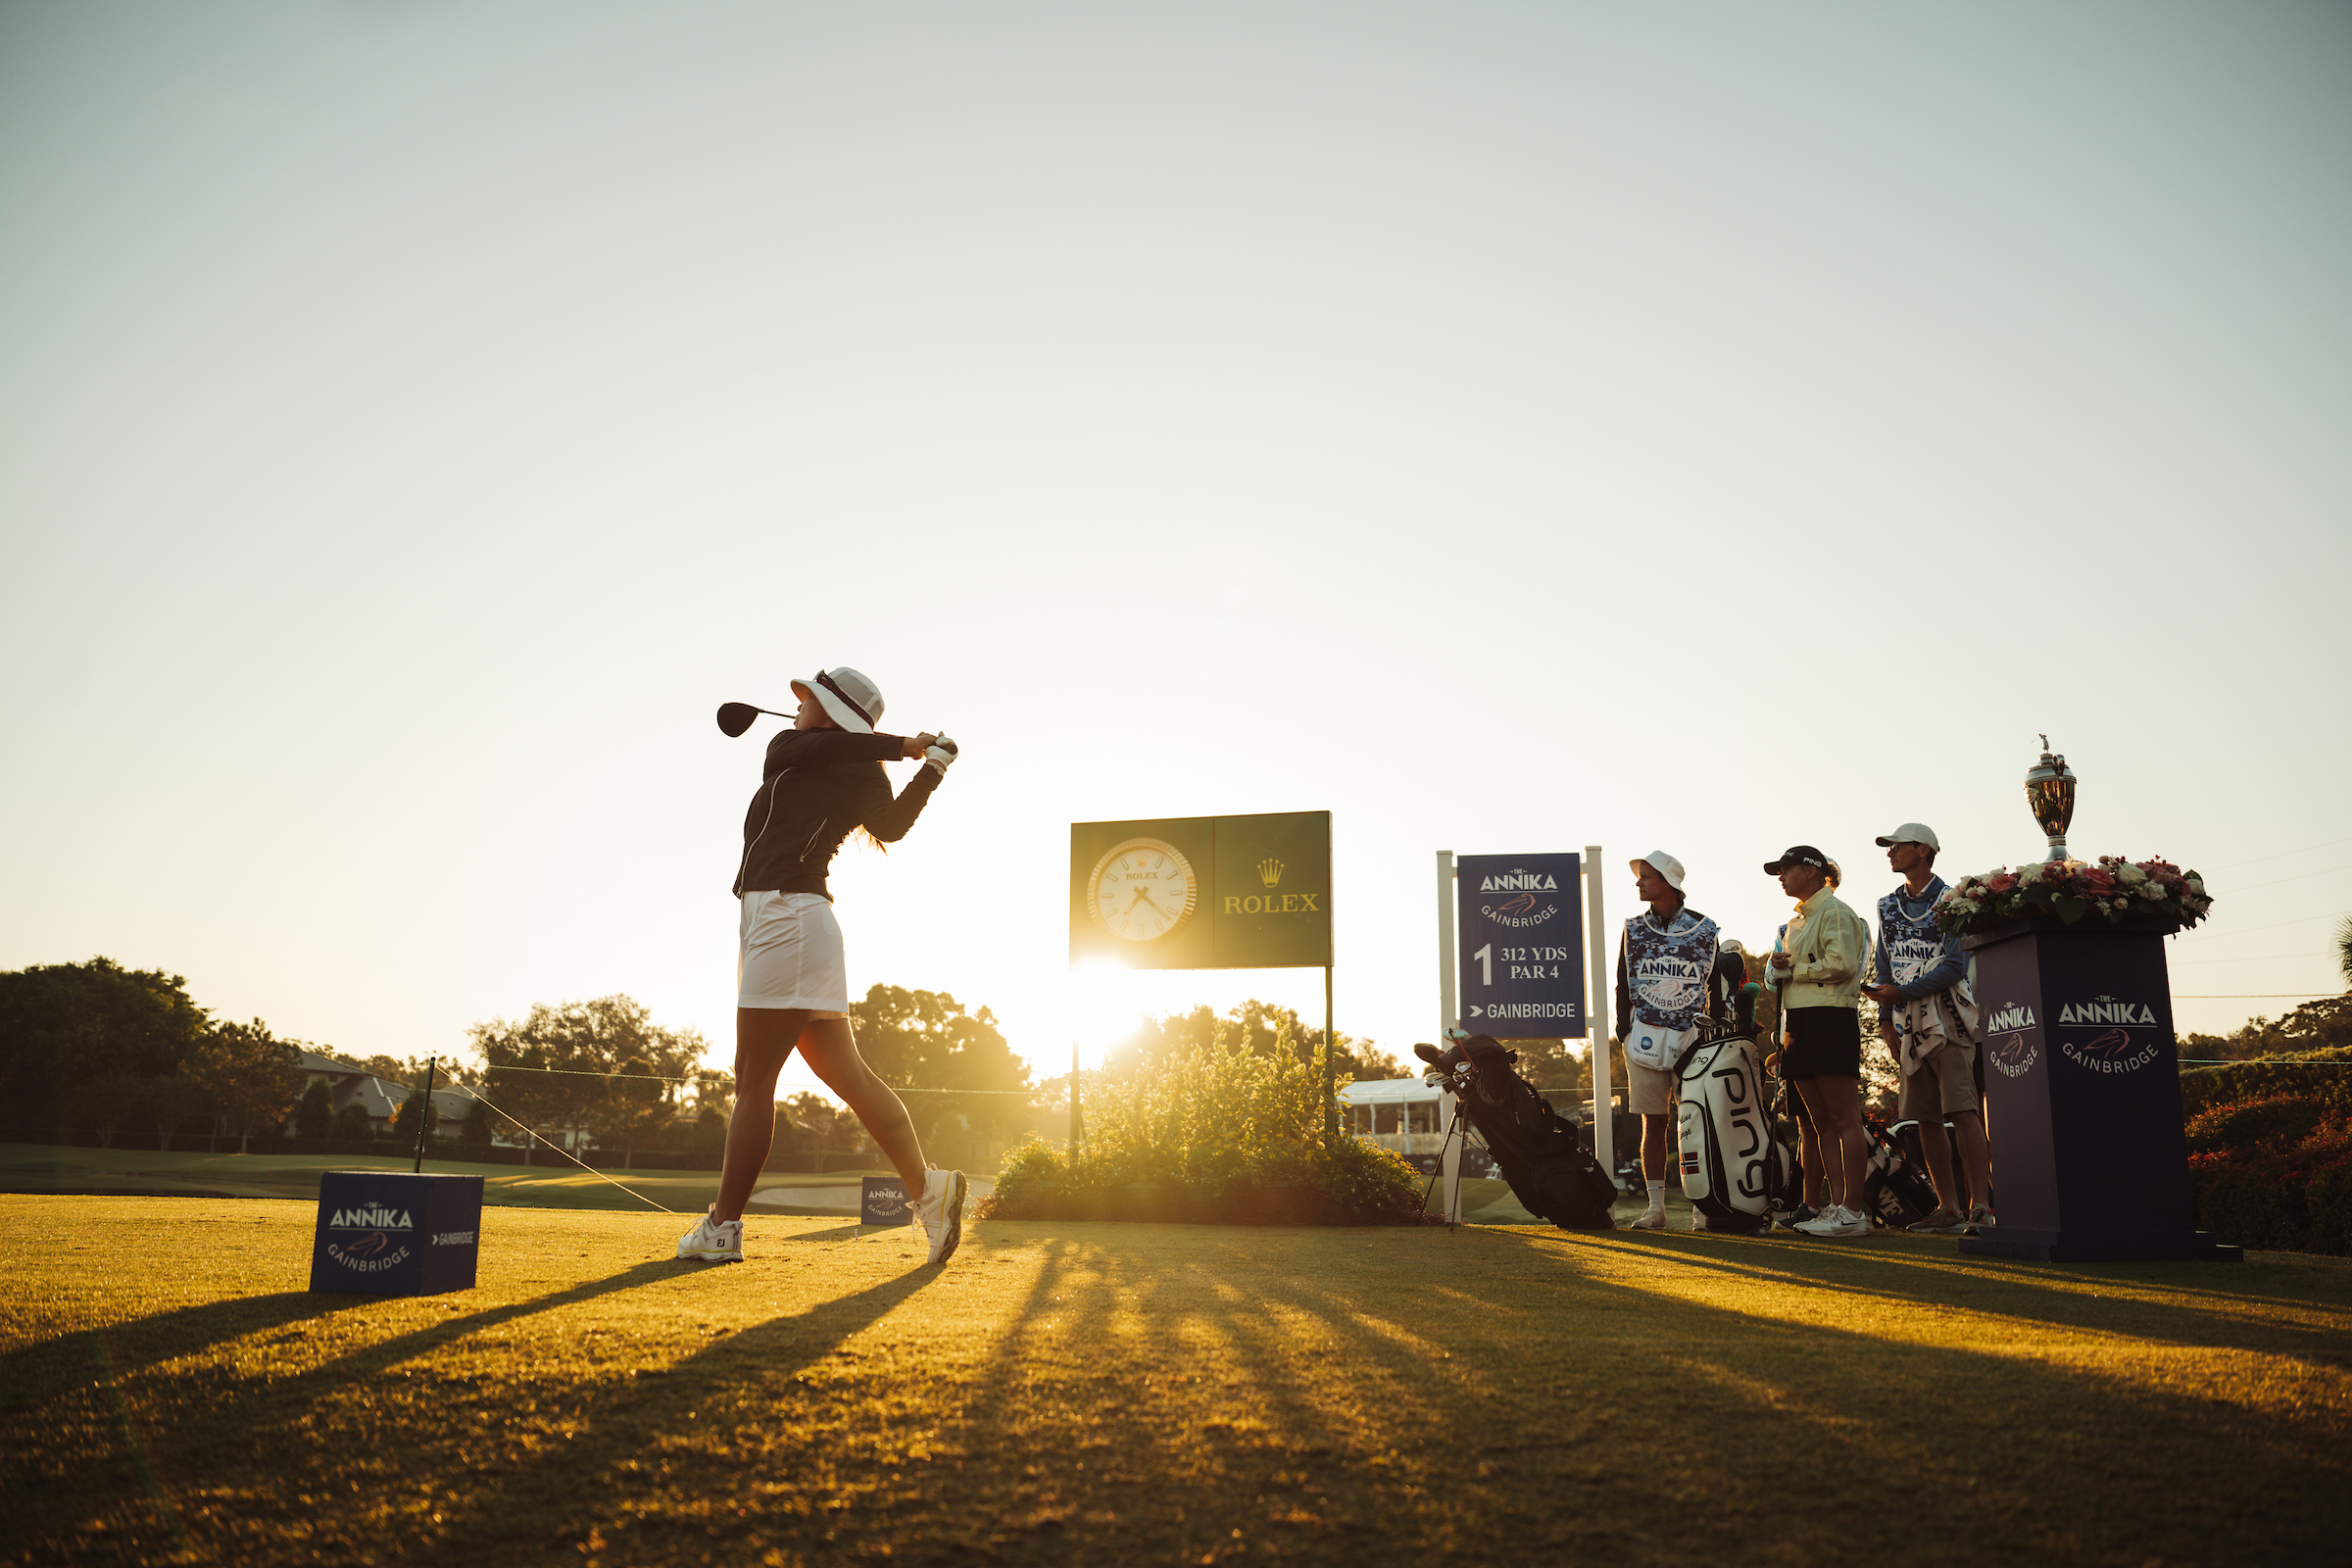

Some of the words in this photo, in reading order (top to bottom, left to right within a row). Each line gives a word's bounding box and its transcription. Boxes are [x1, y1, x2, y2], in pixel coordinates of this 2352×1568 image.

[1803, 857, 1823, 868] PING
[1126, 871, 1158, 880] ROLEX
[1480, 874, 1558, 891] ANNIKA
[1223, 893, 1320, 914] ROLEX
[1481, 904, 1558, 928] GAINBRIDGE
[1500, 947, 1526, 961] 312
[1531, 947, 1567, 961] YDS
[1474, 943, 1492, 986] 1
[1510, 965, 1545, 979] PAR
[1549, 964, 1559, 979] 4
[1641, 961, 1698, 978] ANNIKA
[1641, 986, 1695, 1008] GAINBRIDGE
[1487, 1003, 1576, 1018] GAINBRIDGE
[1987, 1005, 2036, 1033] ANNIKA
[2059, 1002, 2157, 1024] ANNIKA
[1989, 1045, 2038, 1078] GAINBRIDGE
[2062, 1042, 2159, 1074] GAINBRIDGE
[867, 1190, 905, 1199] ANNIKA
[1878, 1184, 1904, 1217] WF
[328, 1208, 414, 1228] ANNIKA
[867, 1203, 904, 1216] GAINBRIDGE
[438, 1231, 474, 1246] GAINBRIDGE
[716, 1239, 725, 1248] FJ
[327, 1243, 411, 1272] GAINBRIDGE
